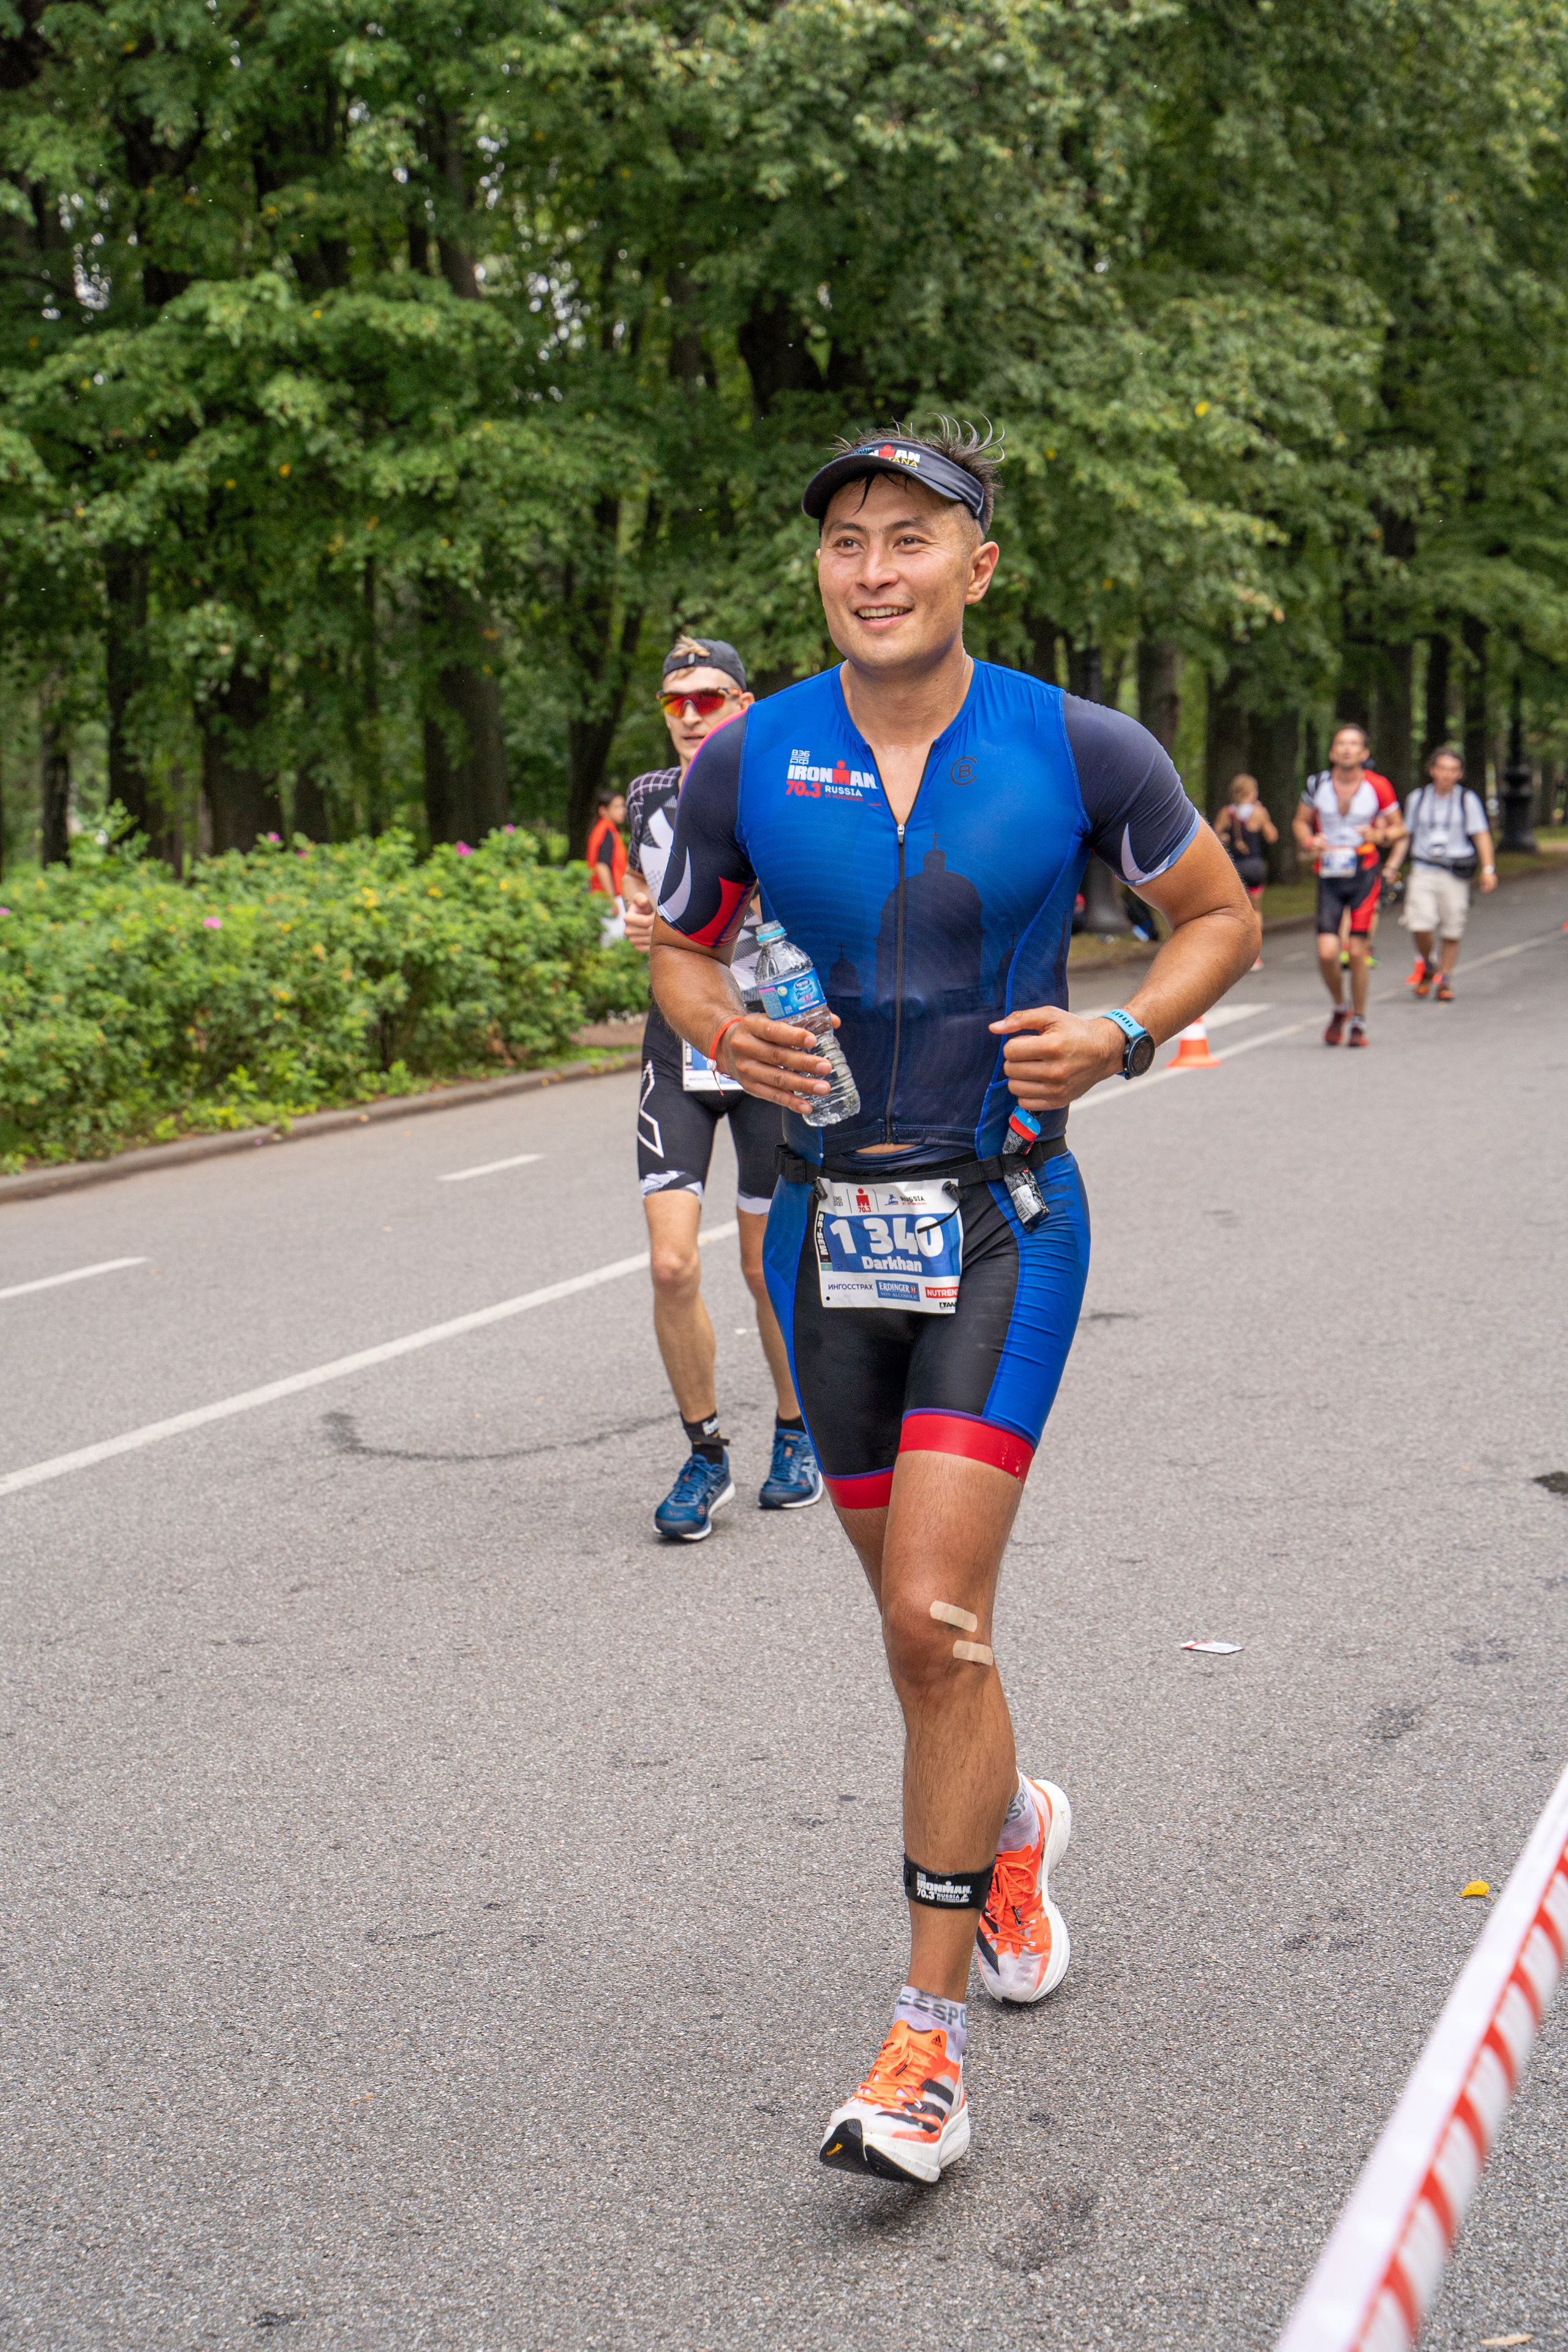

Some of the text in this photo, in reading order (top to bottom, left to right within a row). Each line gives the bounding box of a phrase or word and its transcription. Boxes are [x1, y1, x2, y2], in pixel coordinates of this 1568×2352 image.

[787, 760, 877, 789] IRONMAN
[786, 780, 863, 798] 70.3 RUSSIA
[817, 1213, 829, 1255] M35-39
[861, 1256, 922, 1272] Darkhan
[878, 1282, 911, 1293] ERDINGER
[917, 1880, 971, 1894] IRONMAN
[917, 1888, 935, 1900] 70.3
